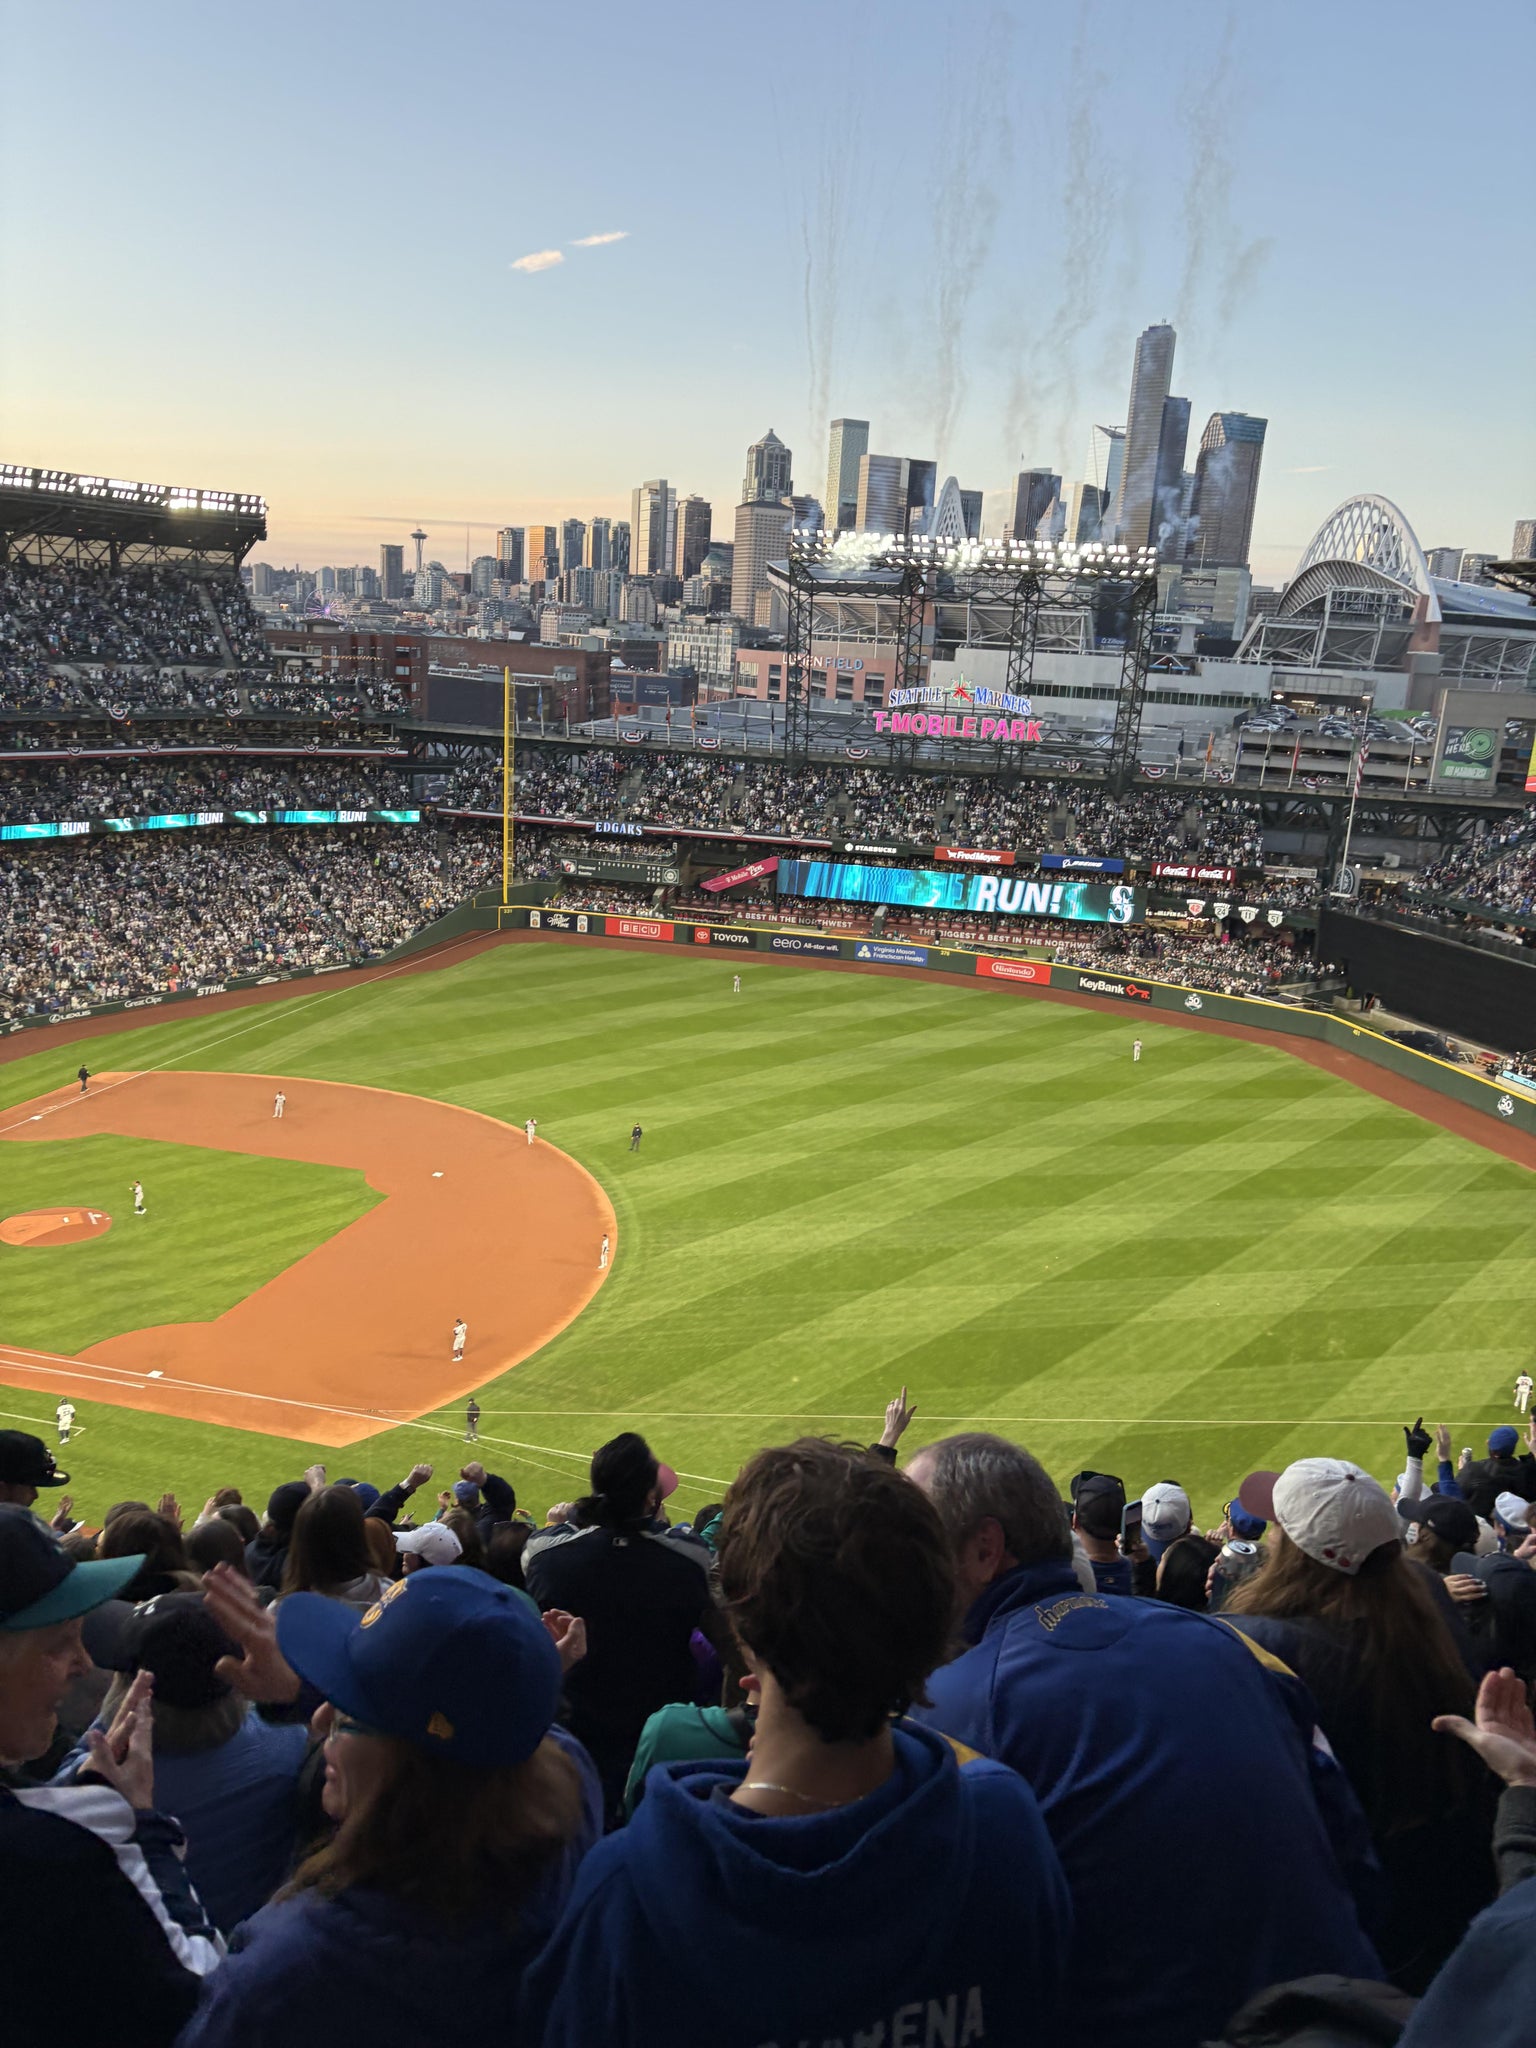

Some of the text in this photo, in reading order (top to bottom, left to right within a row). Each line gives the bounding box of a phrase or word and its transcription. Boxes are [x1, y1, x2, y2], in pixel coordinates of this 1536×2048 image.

[825, 657, 864, 671] FIELD
[888, 686, 1032, 715] SEATTLE MARINERS
[872, 711, 1046, 743] T-MOBILE PARK
[1445, 742, 1472, 755] HERE
[198, 811, 224, 824] RUN!
[337, 811, 367, 822] RUN!
[61, 821, 90, 834] RUN!
[595, 822, 643, 836] EDGARS
[854, 844, 897, 854] STARBUCKS
[975, 876, 1064, 913] RUN!
[1190, 904, 1200, 912] 42
[1217, 908, 1226, 916] 24
[745, 912, 767, 921] BEST
[768, 914, 778, 922] IN
[779, 915, 797, 924] THE
[798, 916, 853, 928] NORTHWEST
[1270, 915, 1279, 924] 51
[622, 923, 658, 935] BECU
[712, 932, 750, 944] TOYOTA
[918, 927, 936, 936] THE
[987, 933, 1010, 943] BEST
[1012, 935, 1022, 944] IN
[1024, 937, 1042, 946] THE
[772, 937, 802, 950] eero
[873, 945, 916, 955] Virginia Mason
[873, 952, 925, 963] Franciscan Health
[994, 964, 1033, 977] Nintendo
[197, 983, 227, 997] STIHL
[1079, 976, 1125, 995] KeyBank
[124, 995, 164, 1008] Great Clips
[1188, 994, 1200, 1005] 50
[61, 1009, 91, 1021] LEXUS
